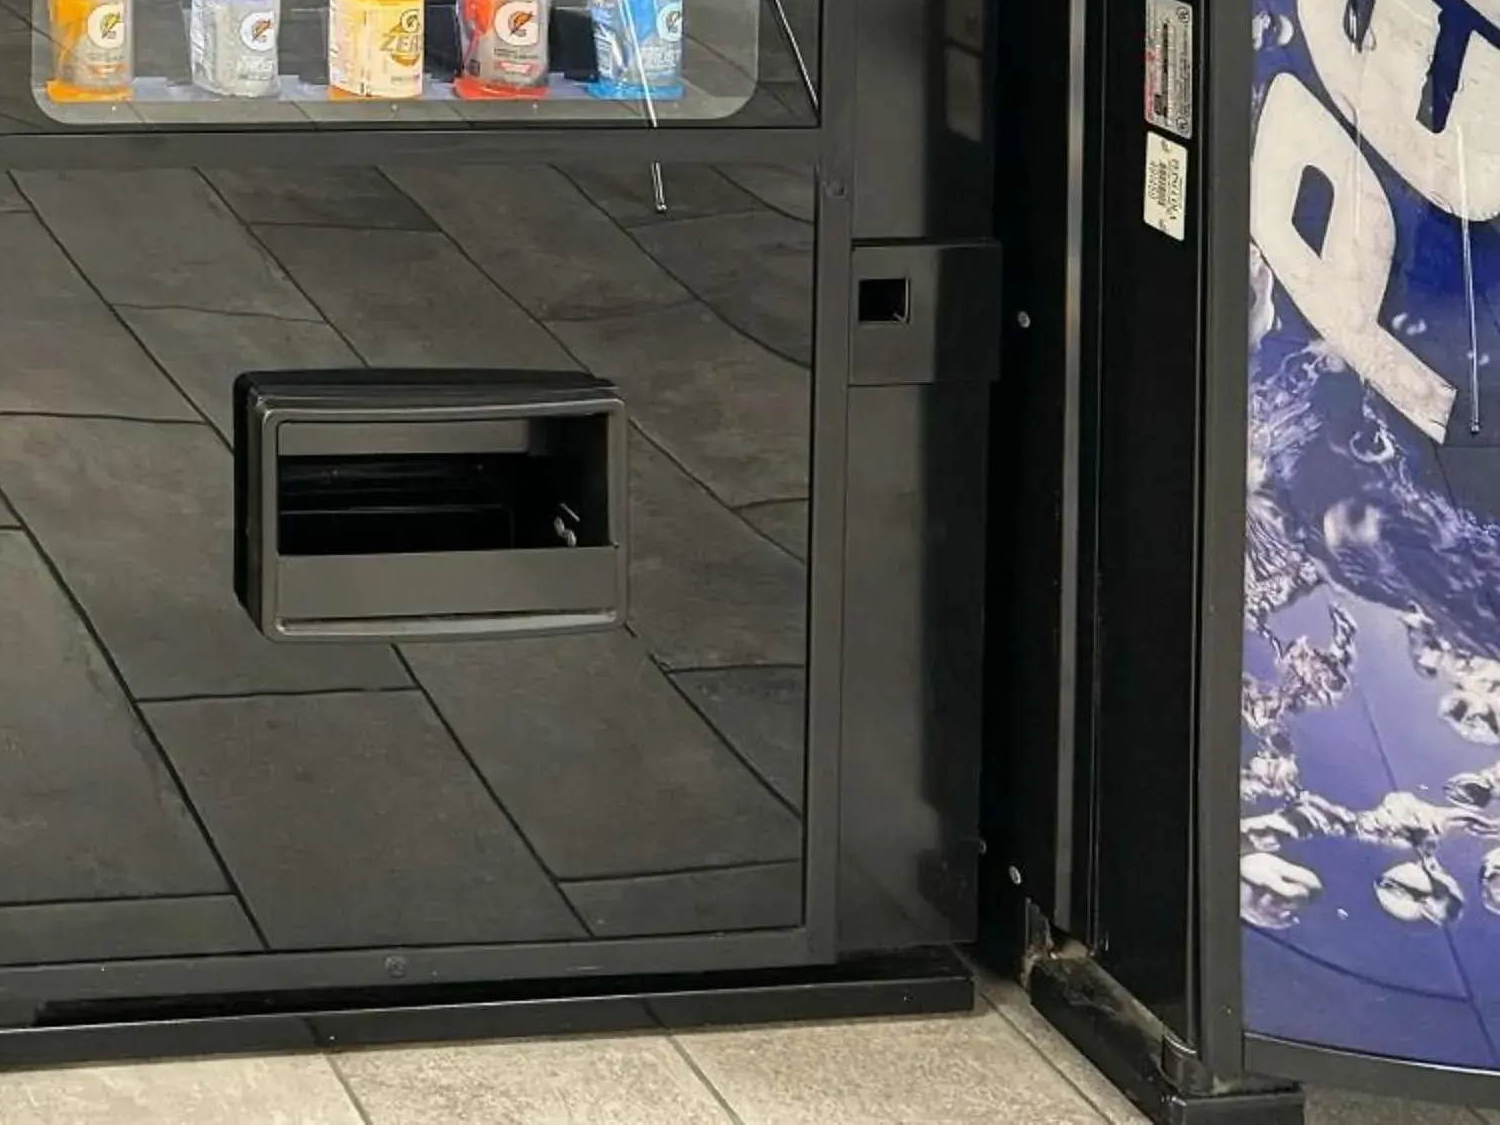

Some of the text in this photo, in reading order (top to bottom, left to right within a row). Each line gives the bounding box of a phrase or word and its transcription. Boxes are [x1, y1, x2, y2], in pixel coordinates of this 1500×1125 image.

[87, 2, 126, 49] G
[239, 11, 275, 52] G
[494, 1, 540, 47] G
